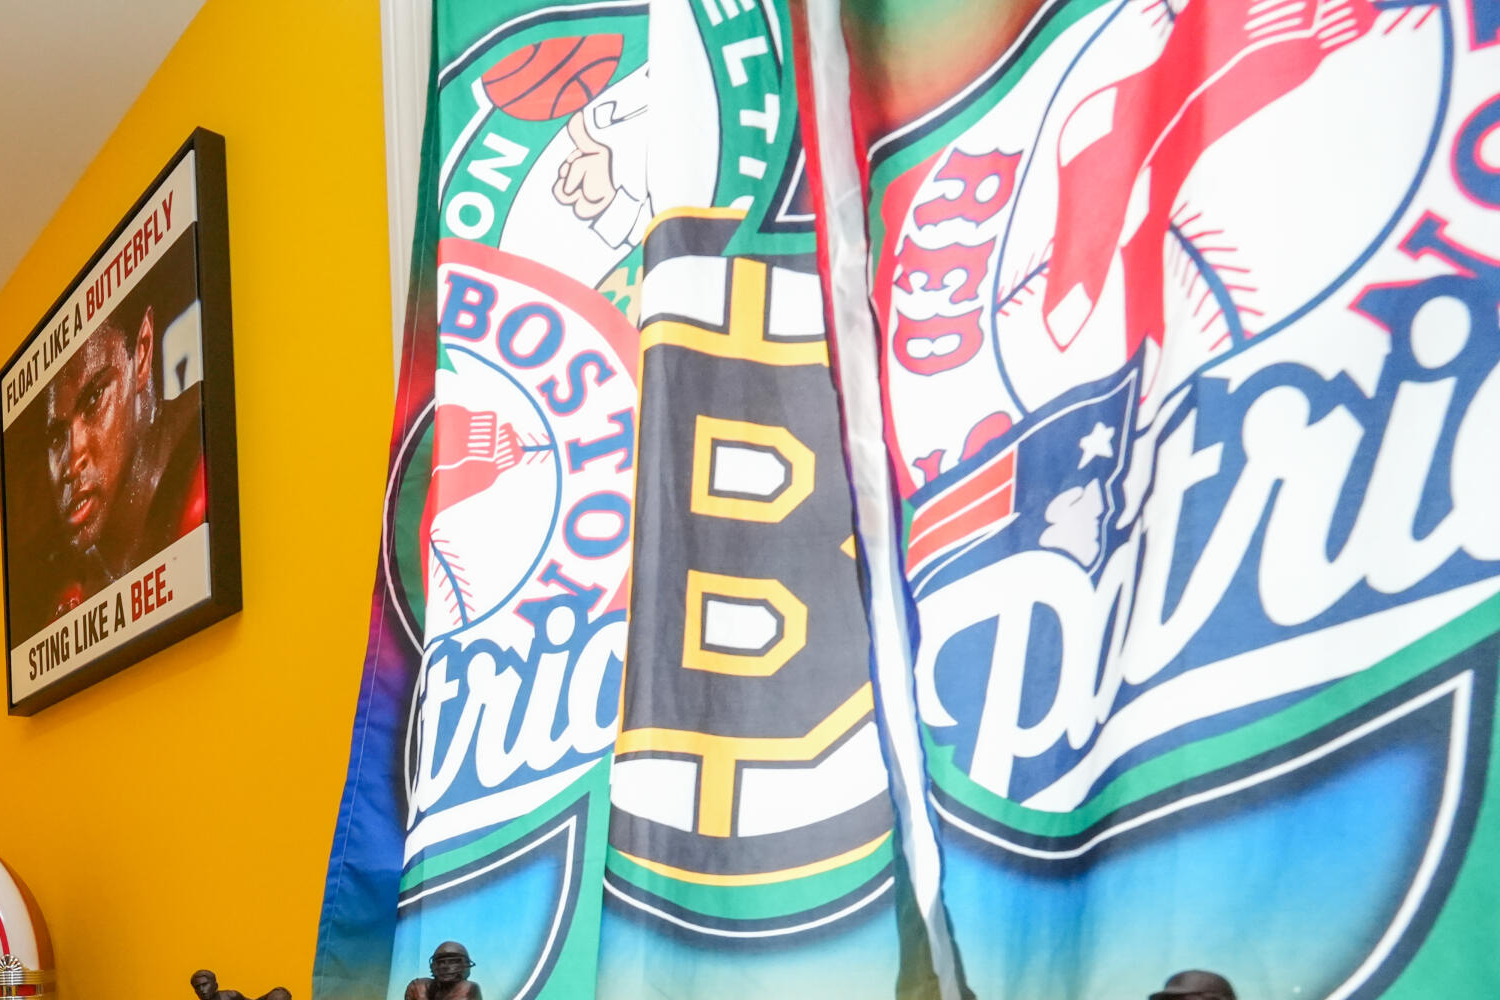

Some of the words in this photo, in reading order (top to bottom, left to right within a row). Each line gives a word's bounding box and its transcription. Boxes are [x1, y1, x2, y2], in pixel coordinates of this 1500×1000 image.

[6, 349, 42, 413] FLOAT
[43, 314, 70, 372] LIKE
[74, 302, 83, 338] A
[86, 189, 174, 323] BUTTERFLY
[894, 147, 1024, 377] RED
[29, 626, 70, 681] STING
[74, 600, 109, 655] LIKE
[114, 592, 126, 632] A
[130, 563, 173, 623] BEE.
